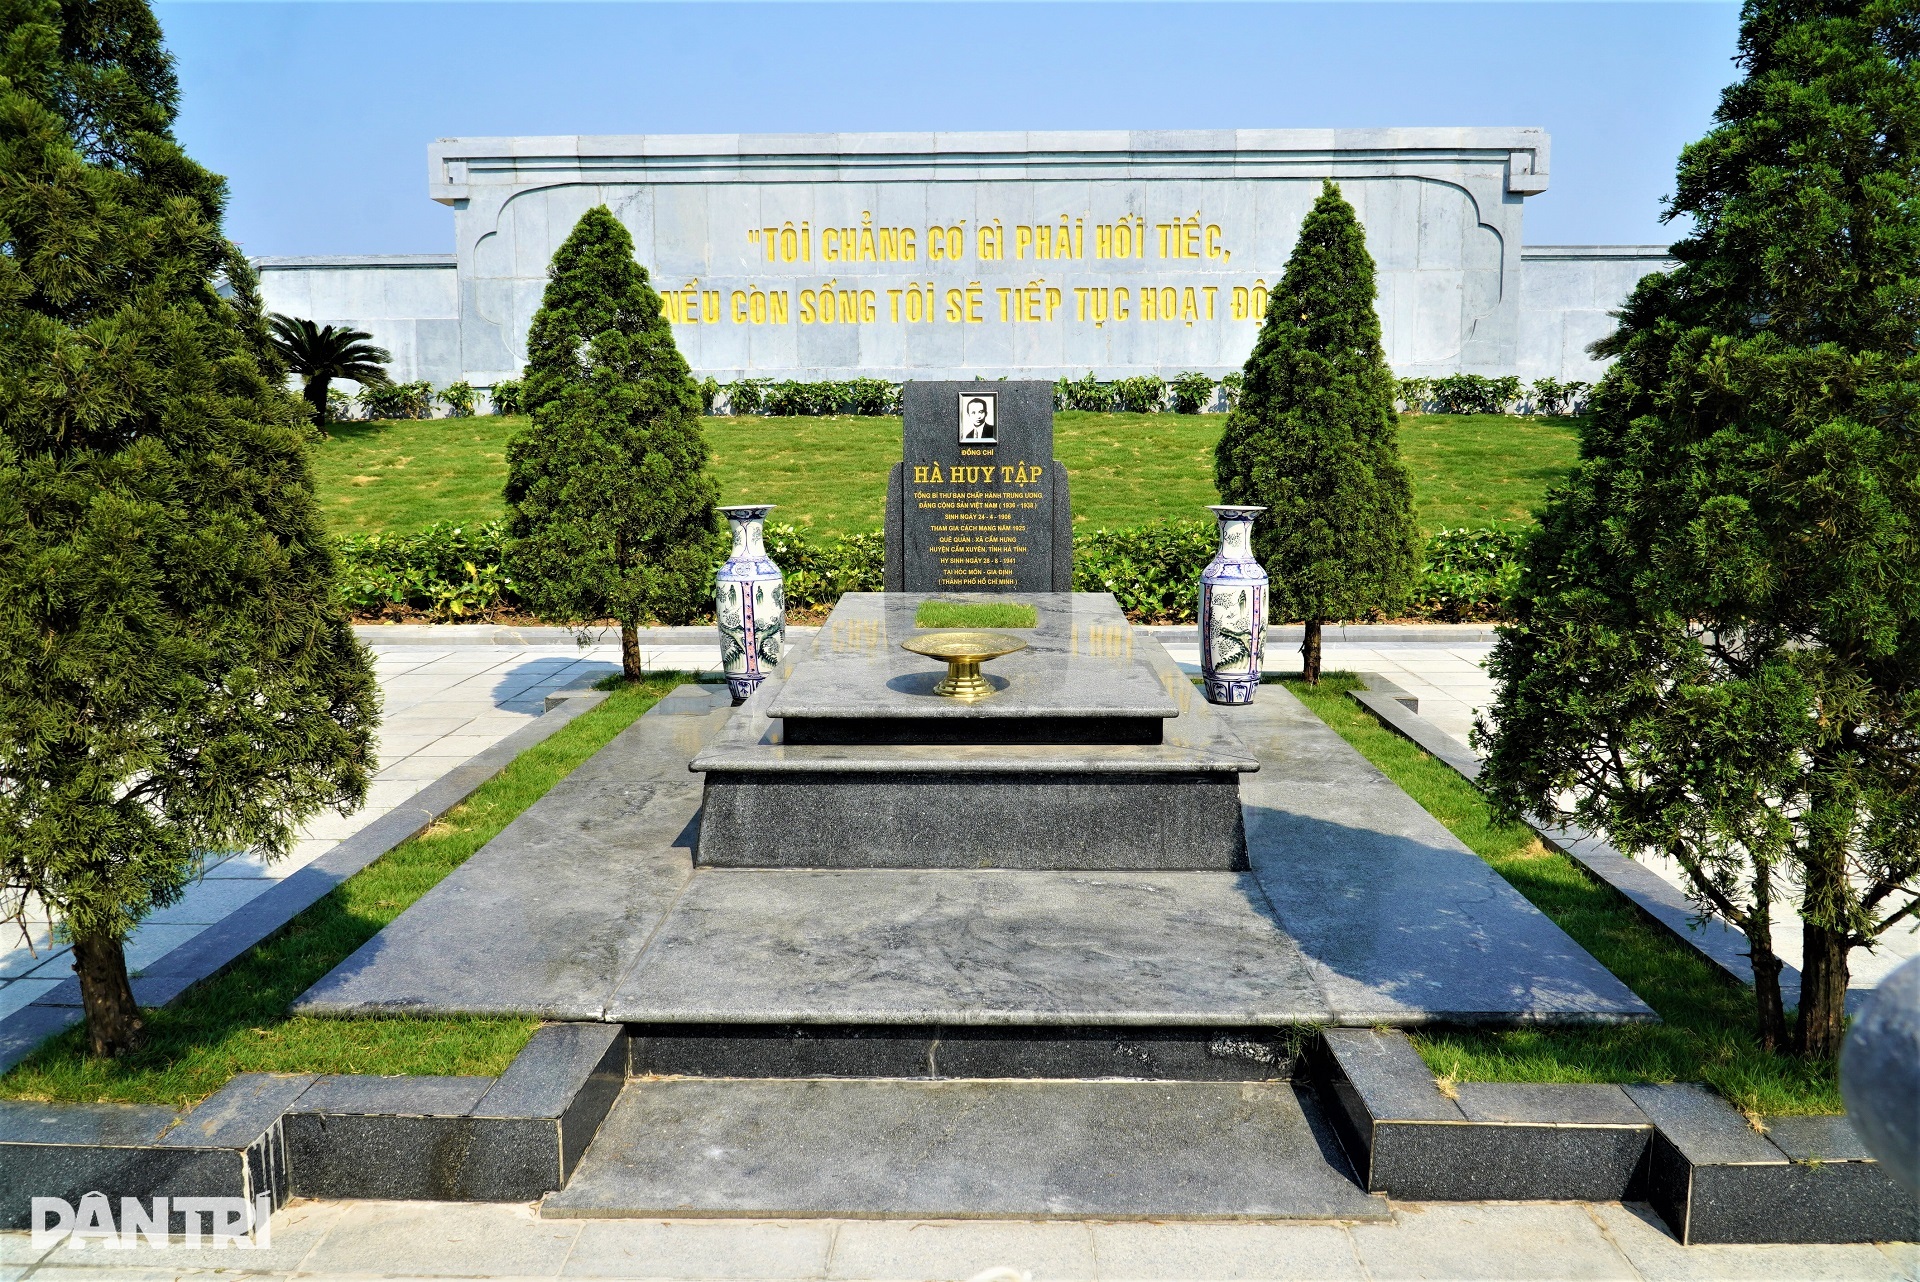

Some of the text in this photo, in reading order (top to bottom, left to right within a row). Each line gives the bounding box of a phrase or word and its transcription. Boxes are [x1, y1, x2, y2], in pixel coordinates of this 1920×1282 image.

[822, 210, 916, 262] CHẲNG
[928, 218, 966, 261] CÓ
[978, 218, 1003, 260] GÌ
[1016, 213, 1083, 260] PHẢI
[1096, 212, 1144, 260] HỐI
[1156, 209, 1231, 264] TIẾC,
[660, 278, 1268, 328] NẾU CÒN SỐNG TÔI SẼ TIẾP TỤC HOẠT ĐỘ
[914, 460, 1043, 487] HÀ HUY TẬP
